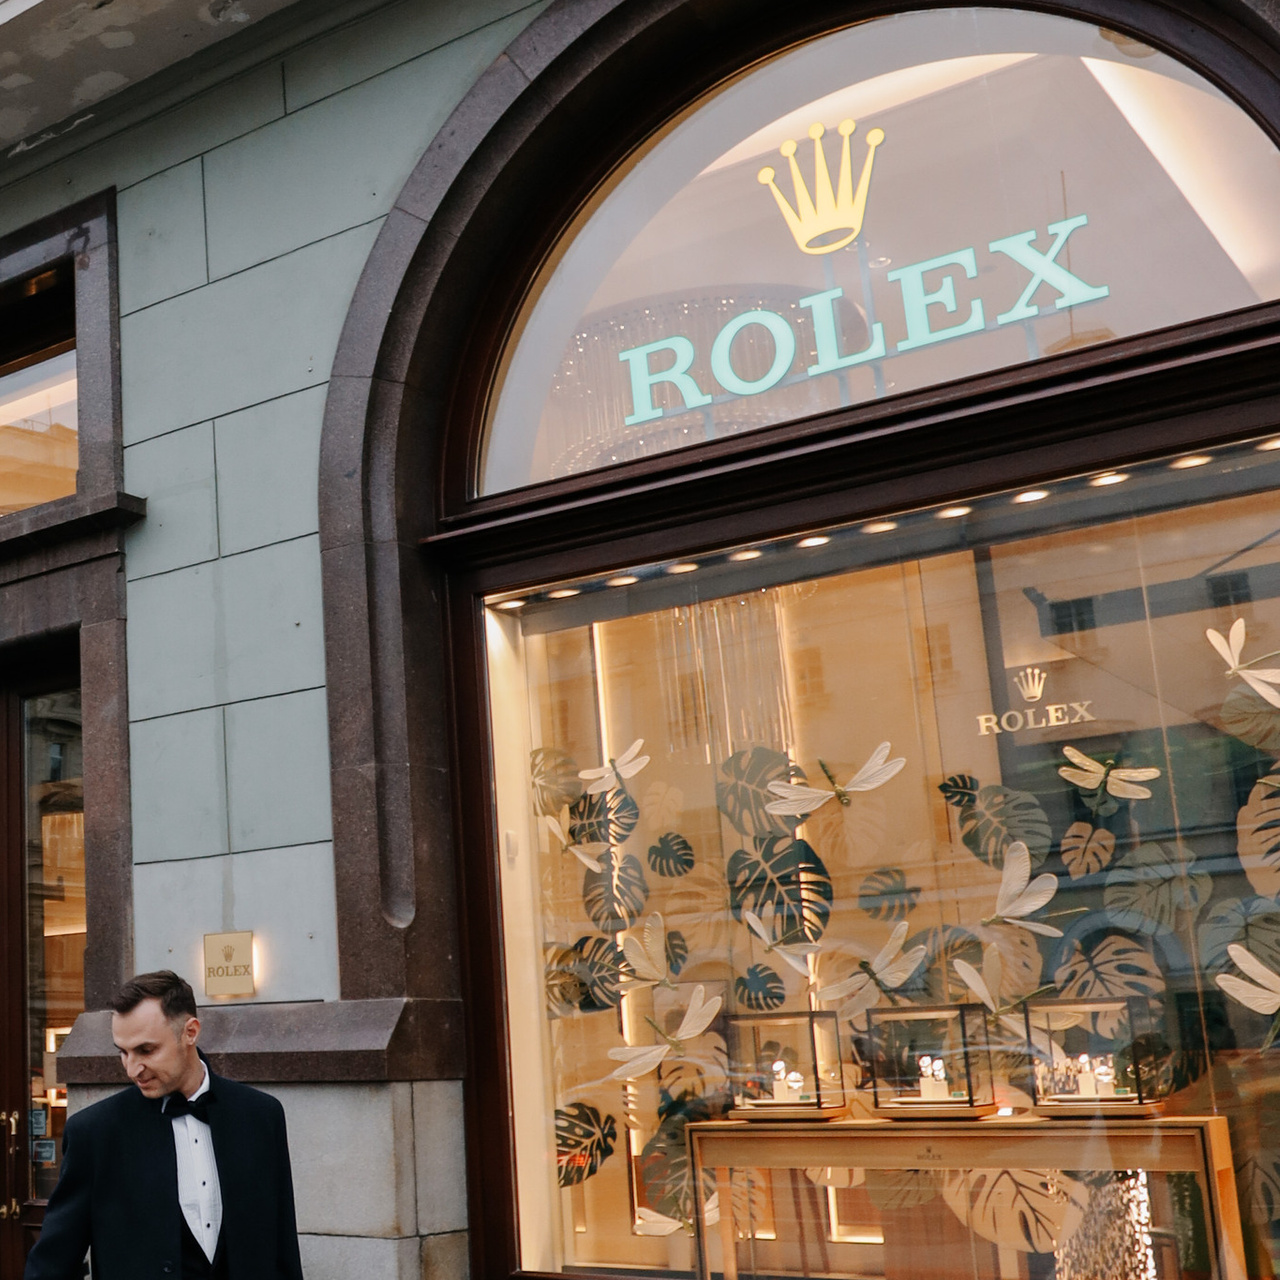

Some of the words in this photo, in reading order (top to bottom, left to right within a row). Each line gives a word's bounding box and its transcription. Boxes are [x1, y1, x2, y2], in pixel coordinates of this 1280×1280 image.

[618, 214, 1110, 426] ROLEX
[976, 700, 1096, 736] ROLEX
[207, 964, 251, 978] ROLEX
